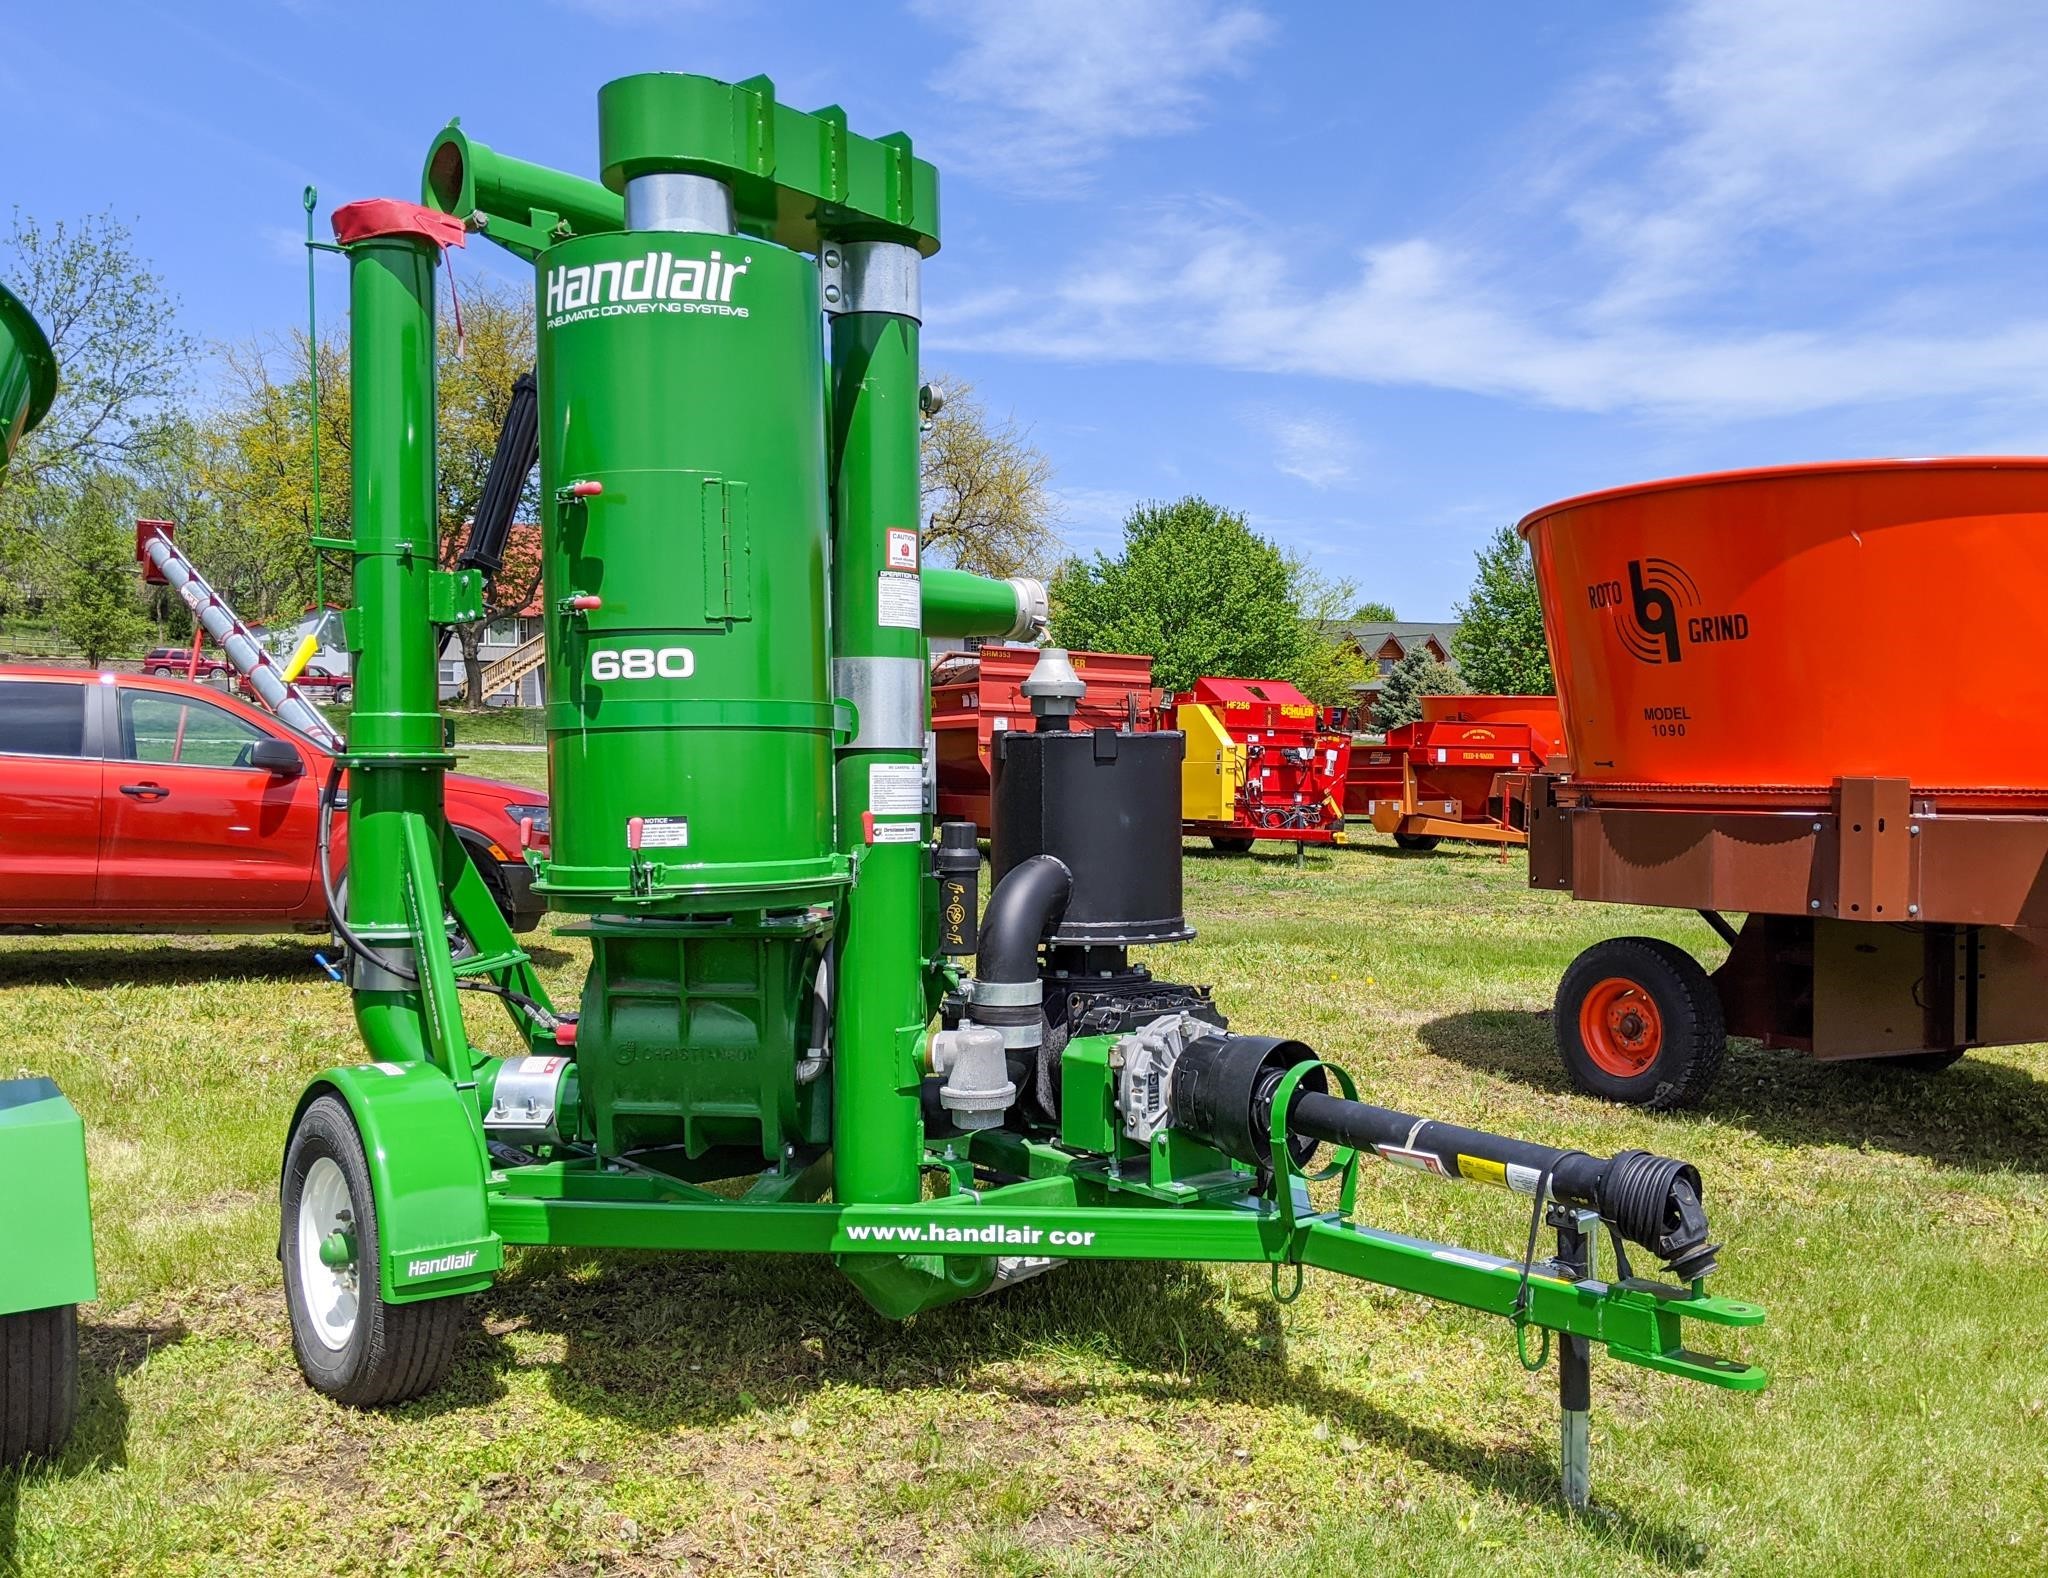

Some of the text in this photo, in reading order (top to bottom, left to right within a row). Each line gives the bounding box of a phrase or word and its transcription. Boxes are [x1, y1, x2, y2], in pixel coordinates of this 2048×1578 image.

[547, 251, 747, 316] Handlair
[547, 308, 600, 331] PNEUMATIC
[683, 303, 749, 318] SYSTEMS
[892, 533, 915, 542] CAUTION
[1588, 581, 1622, 609] ROTO
[1688, 614, 1749, 643] GRIND
[591, 648, 695, 680] 680
[1227, 700, 1250, 710] HF256
[1281, 706, 1314, 717] SCHULER
[1644, 707, 1691, 721] MODEL
[1652, 724, 1686, 736] 1090
[408, 1250, 477, 1277] Handlair
